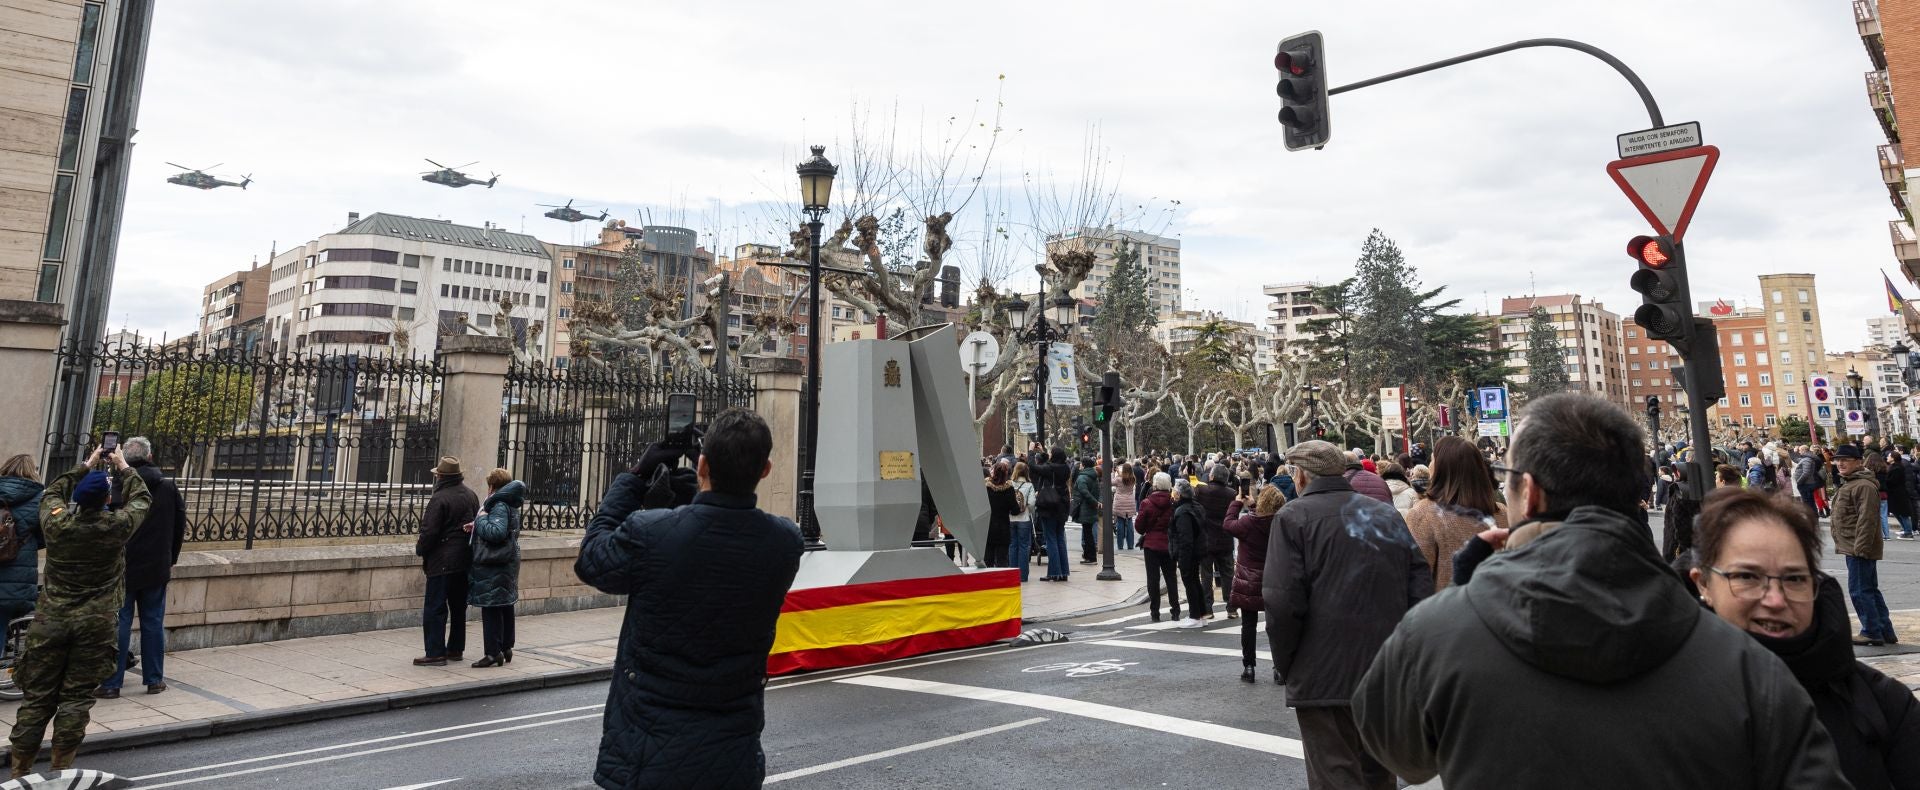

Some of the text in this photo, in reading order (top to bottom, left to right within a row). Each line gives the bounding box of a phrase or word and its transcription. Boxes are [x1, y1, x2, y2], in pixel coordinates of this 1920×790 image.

[1660, 128, 1688, 138] SEMAFORO
[1670, 136, 1693, 145] APAGADO
[1485, 392, 1496, 408] P
